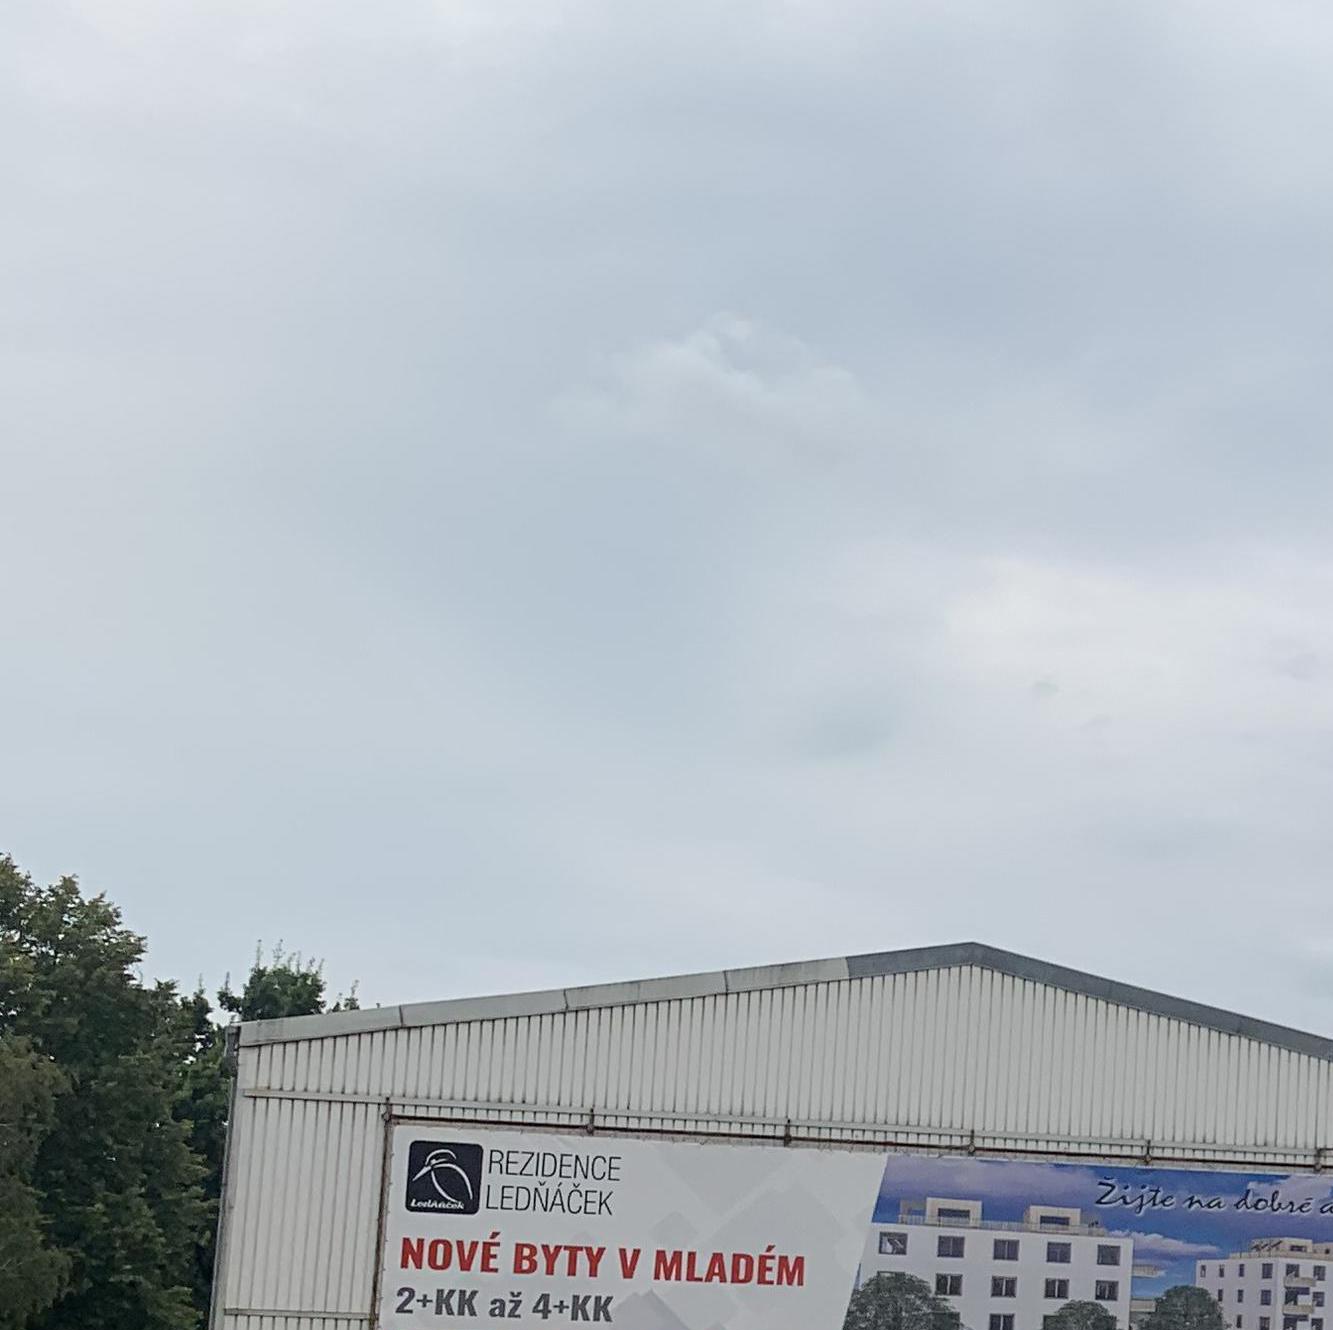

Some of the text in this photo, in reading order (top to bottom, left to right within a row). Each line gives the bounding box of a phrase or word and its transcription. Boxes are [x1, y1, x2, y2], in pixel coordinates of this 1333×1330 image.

[488, 1149, 622, 1182] REZIDENCE
[486, 1181, 614, 1216] LEDŇÁČEK
[1094, 1176, 1176, 1216] Žijte
[1184, 1195, 1224, 1211] na
[1234, 1188, 1312, 1214] dobré
[400, 1232, 805, 1286] NOVÉ BYTY V MLADÉM
[395, 1286, 614, 1322] 2+KK až 4+KK
